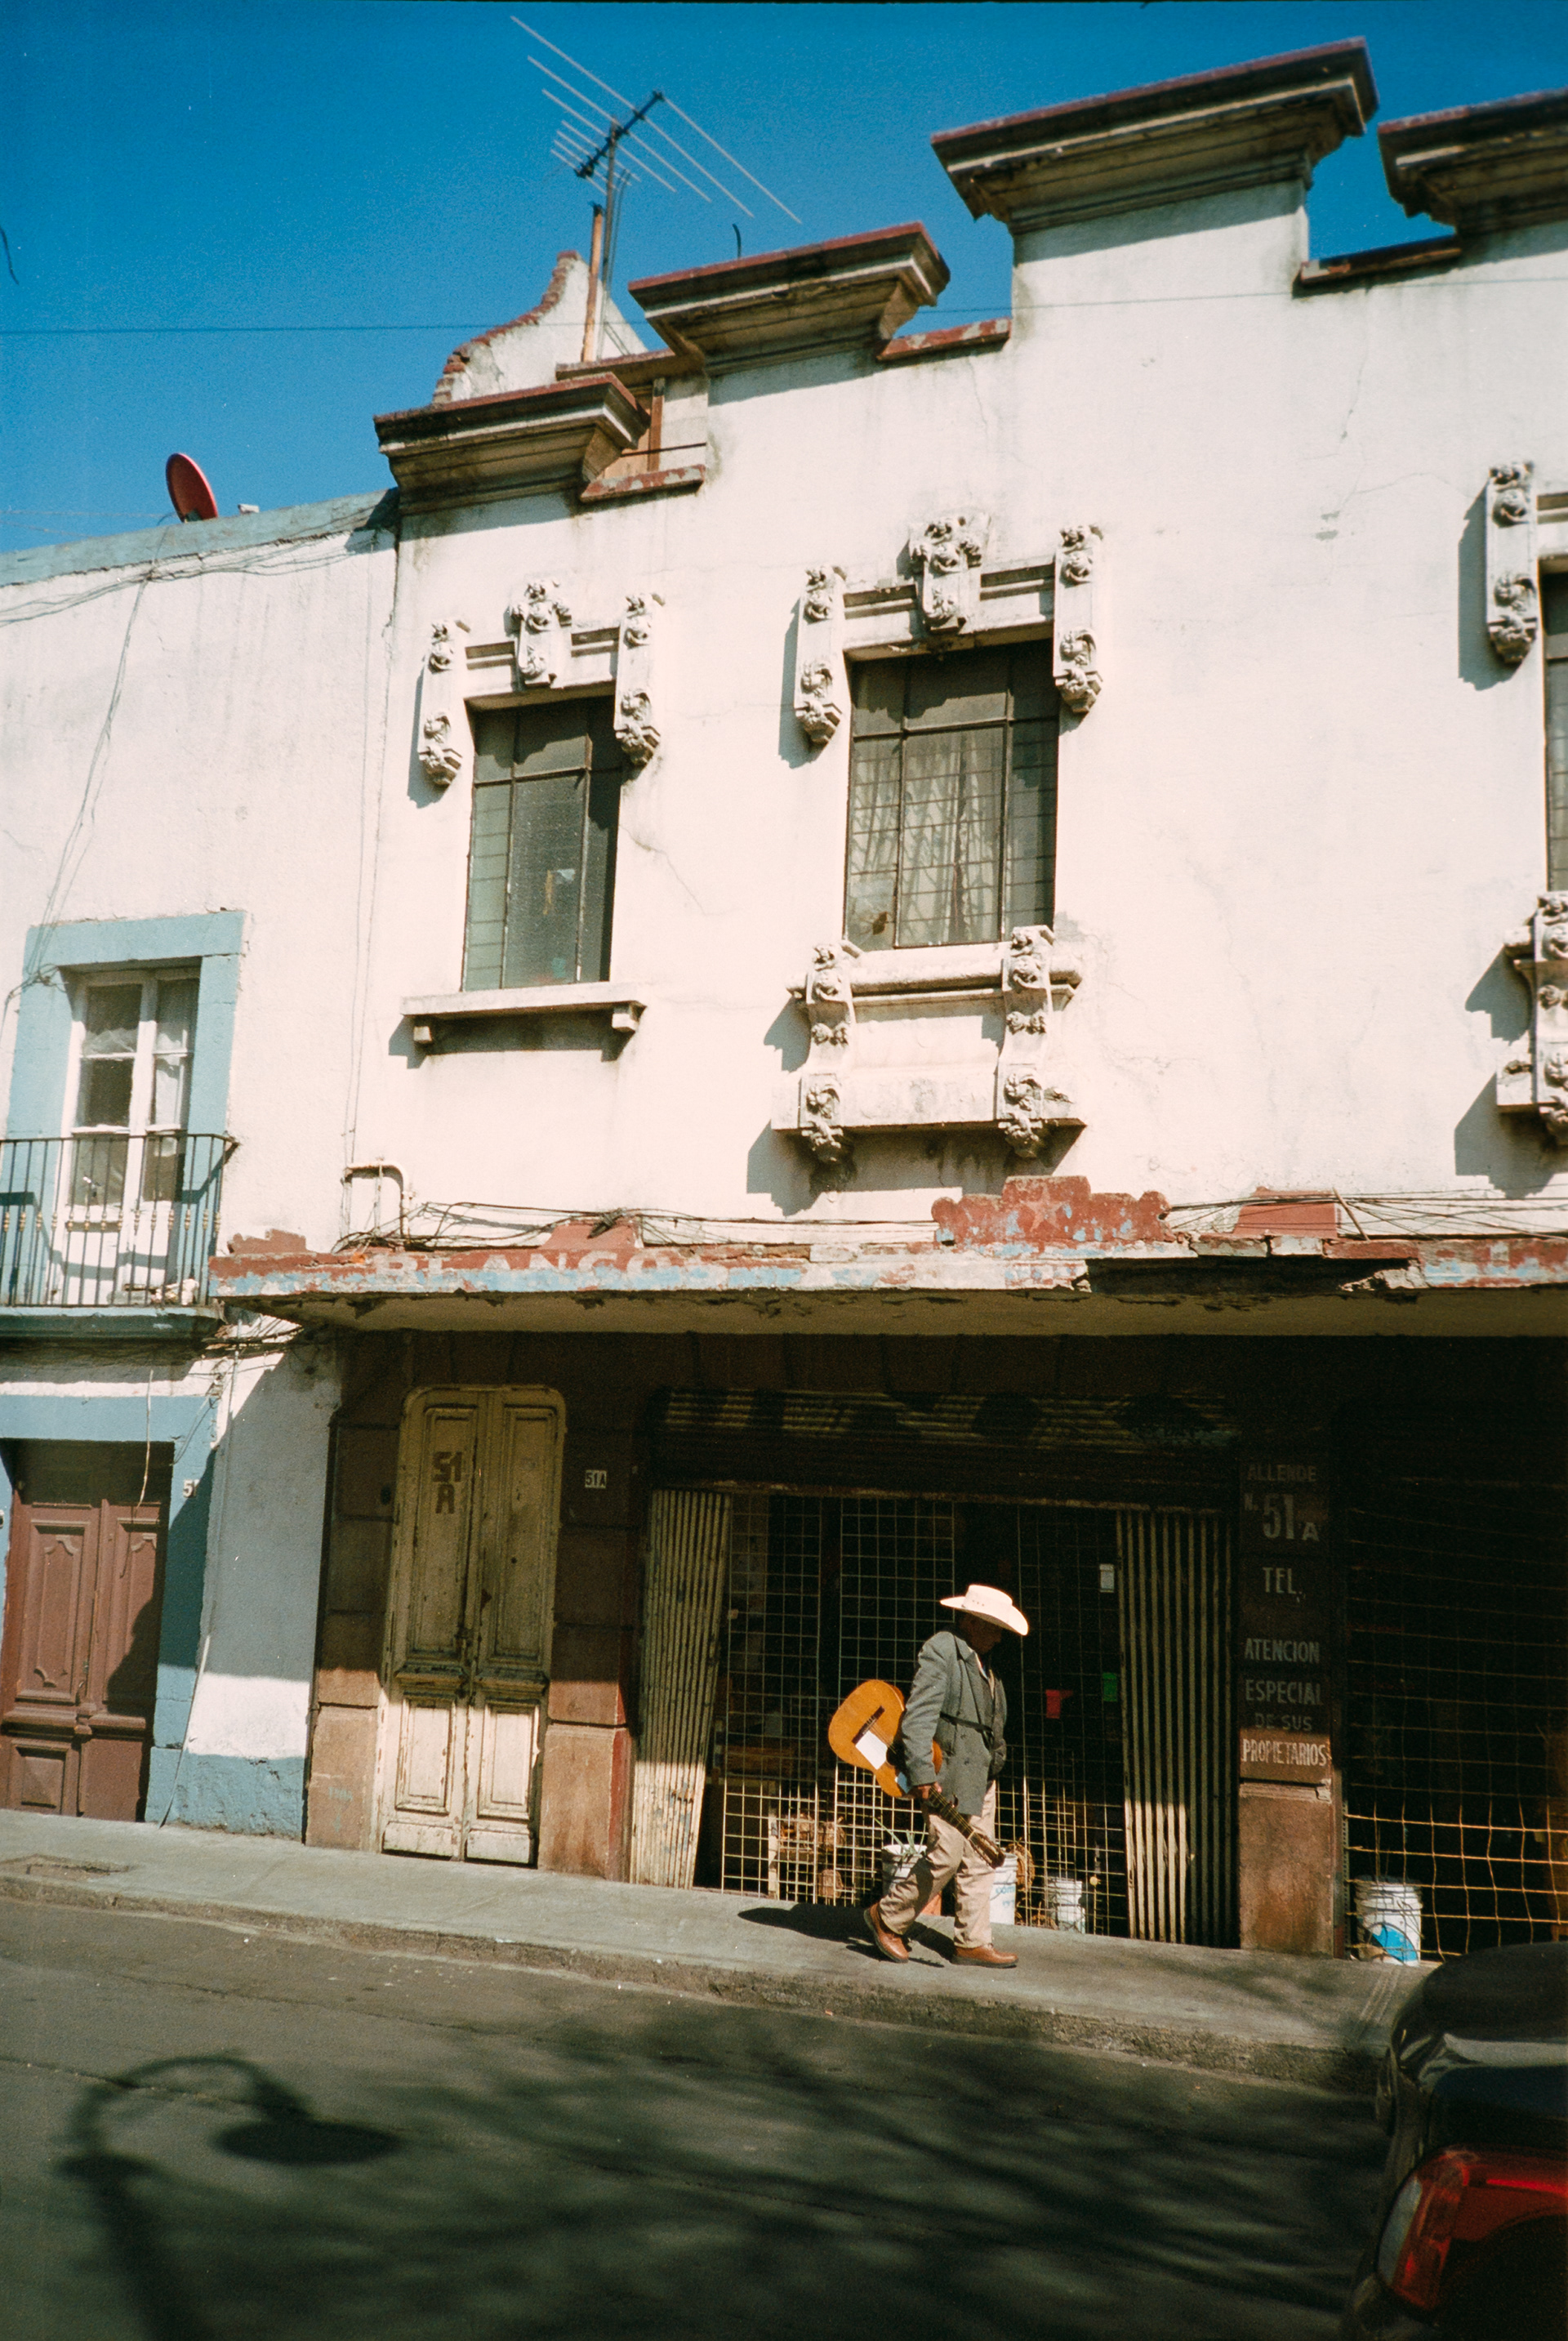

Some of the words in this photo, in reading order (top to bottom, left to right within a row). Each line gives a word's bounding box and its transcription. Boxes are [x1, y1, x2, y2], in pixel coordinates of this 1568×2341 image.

[431, 1451, 462, 1483] 51
[585, 1471, 606, 1487] 51A
[1247, 1464, 1317, 1483] ALLENDE
[1245, 1638, 1321, 1665] ATENCION
[1246, 1679, 1323, 1705] ESPECIAL
[1254, 1712, 1276, 1729] DE
[1281, 1714, 1313, 1732] SUS
[1242, 1738, 1327, 1766] PROPIETARIOS
